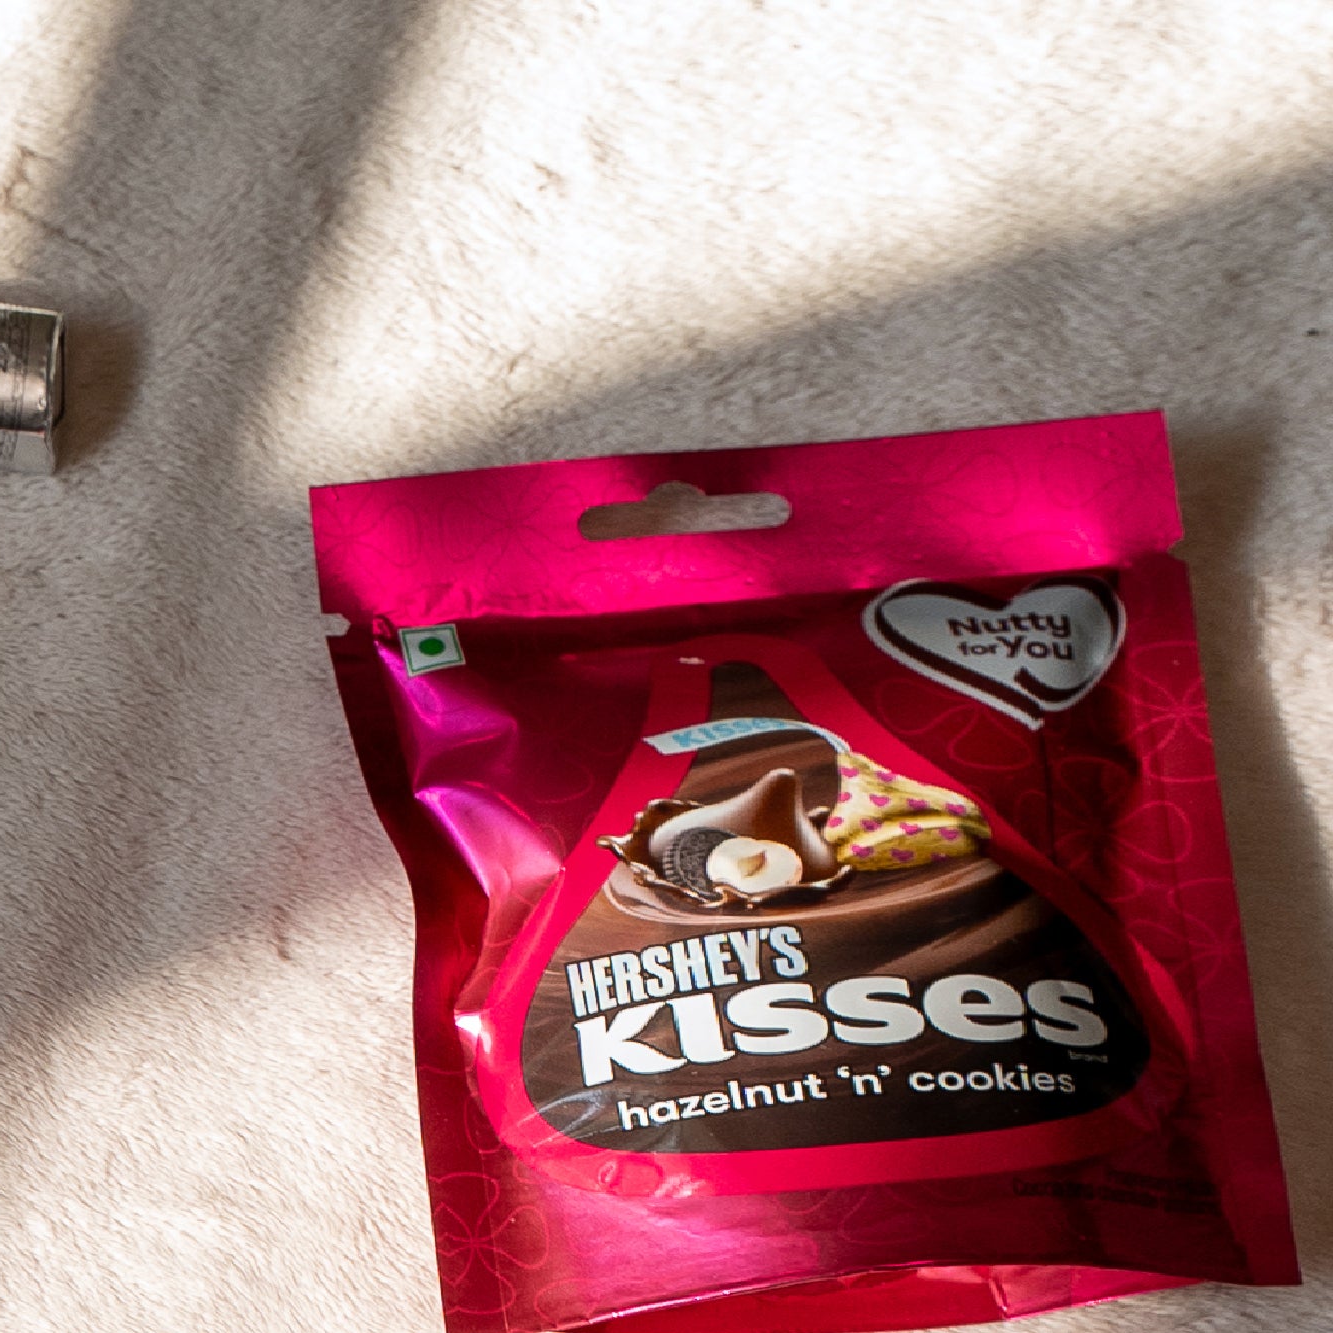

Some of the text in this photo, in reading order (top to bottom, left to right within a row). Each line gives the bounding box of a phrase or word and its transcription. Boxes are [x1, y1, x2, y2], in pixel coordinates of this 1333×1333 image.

[946, 611, 1071, 639] Nutty
[957, 635, 1075, 661] for You
[566, 926, 807, 1017] HERSHEY'S
[618, 1072, 828, 1131] hazelnut
[908, 1062, 1076, 1094] cookies
